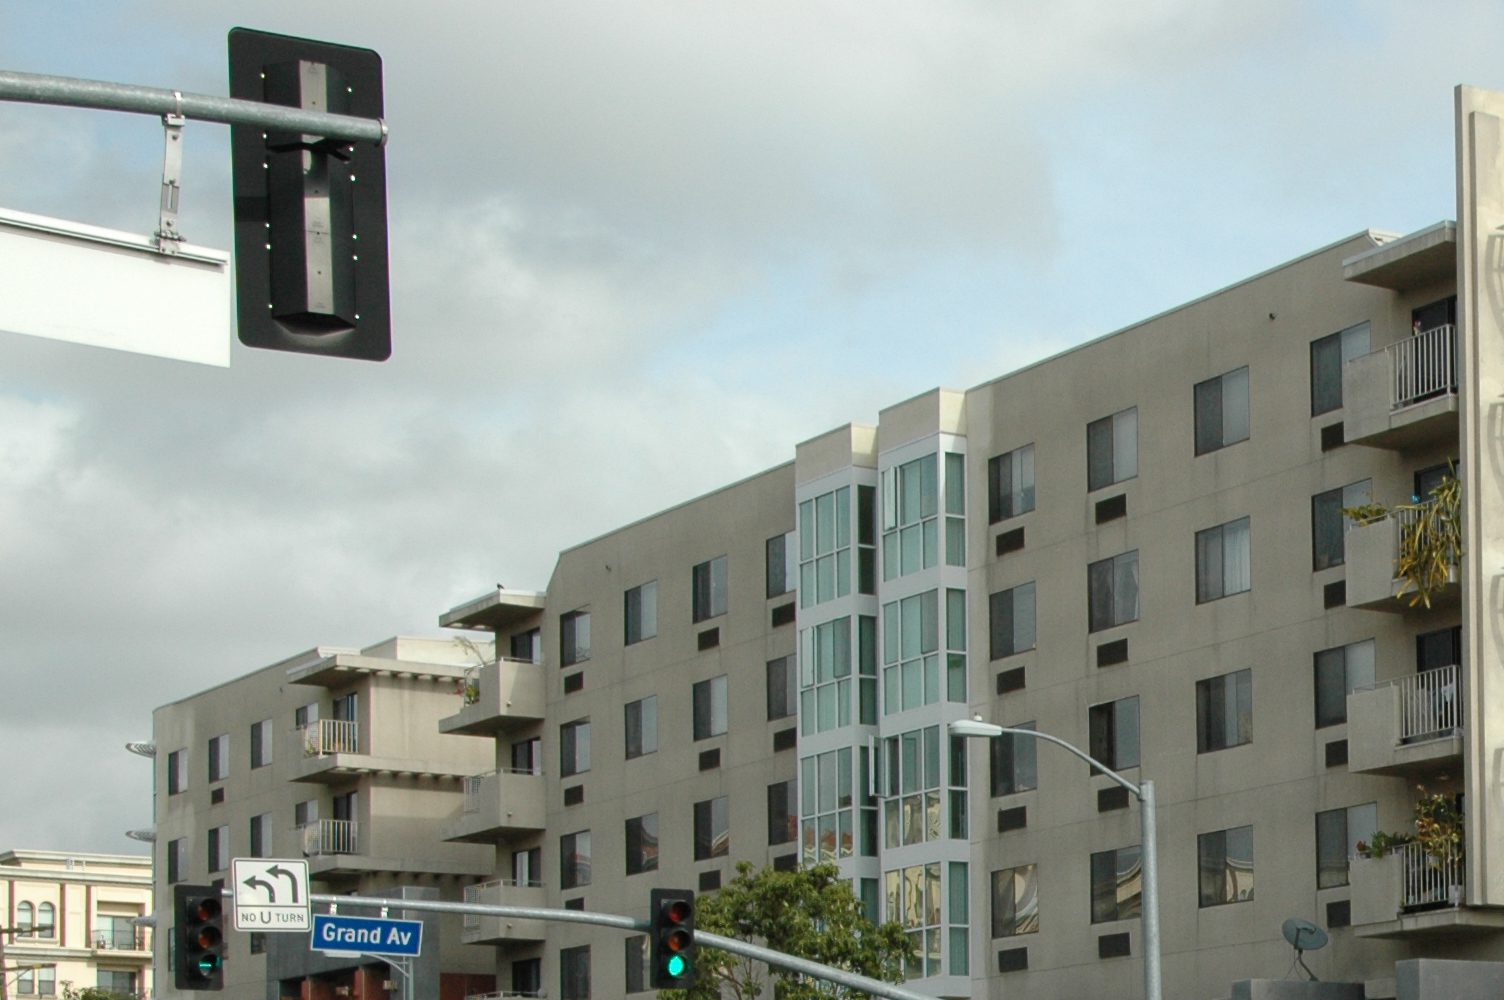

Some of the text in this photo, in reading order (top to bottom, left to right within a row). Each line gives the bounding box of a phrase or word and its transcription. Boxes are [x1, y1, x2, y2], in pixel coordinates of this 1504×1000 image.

[241, 911, 304, 924] NO U TURN
[322, 922, 412, 946] Grand Av
